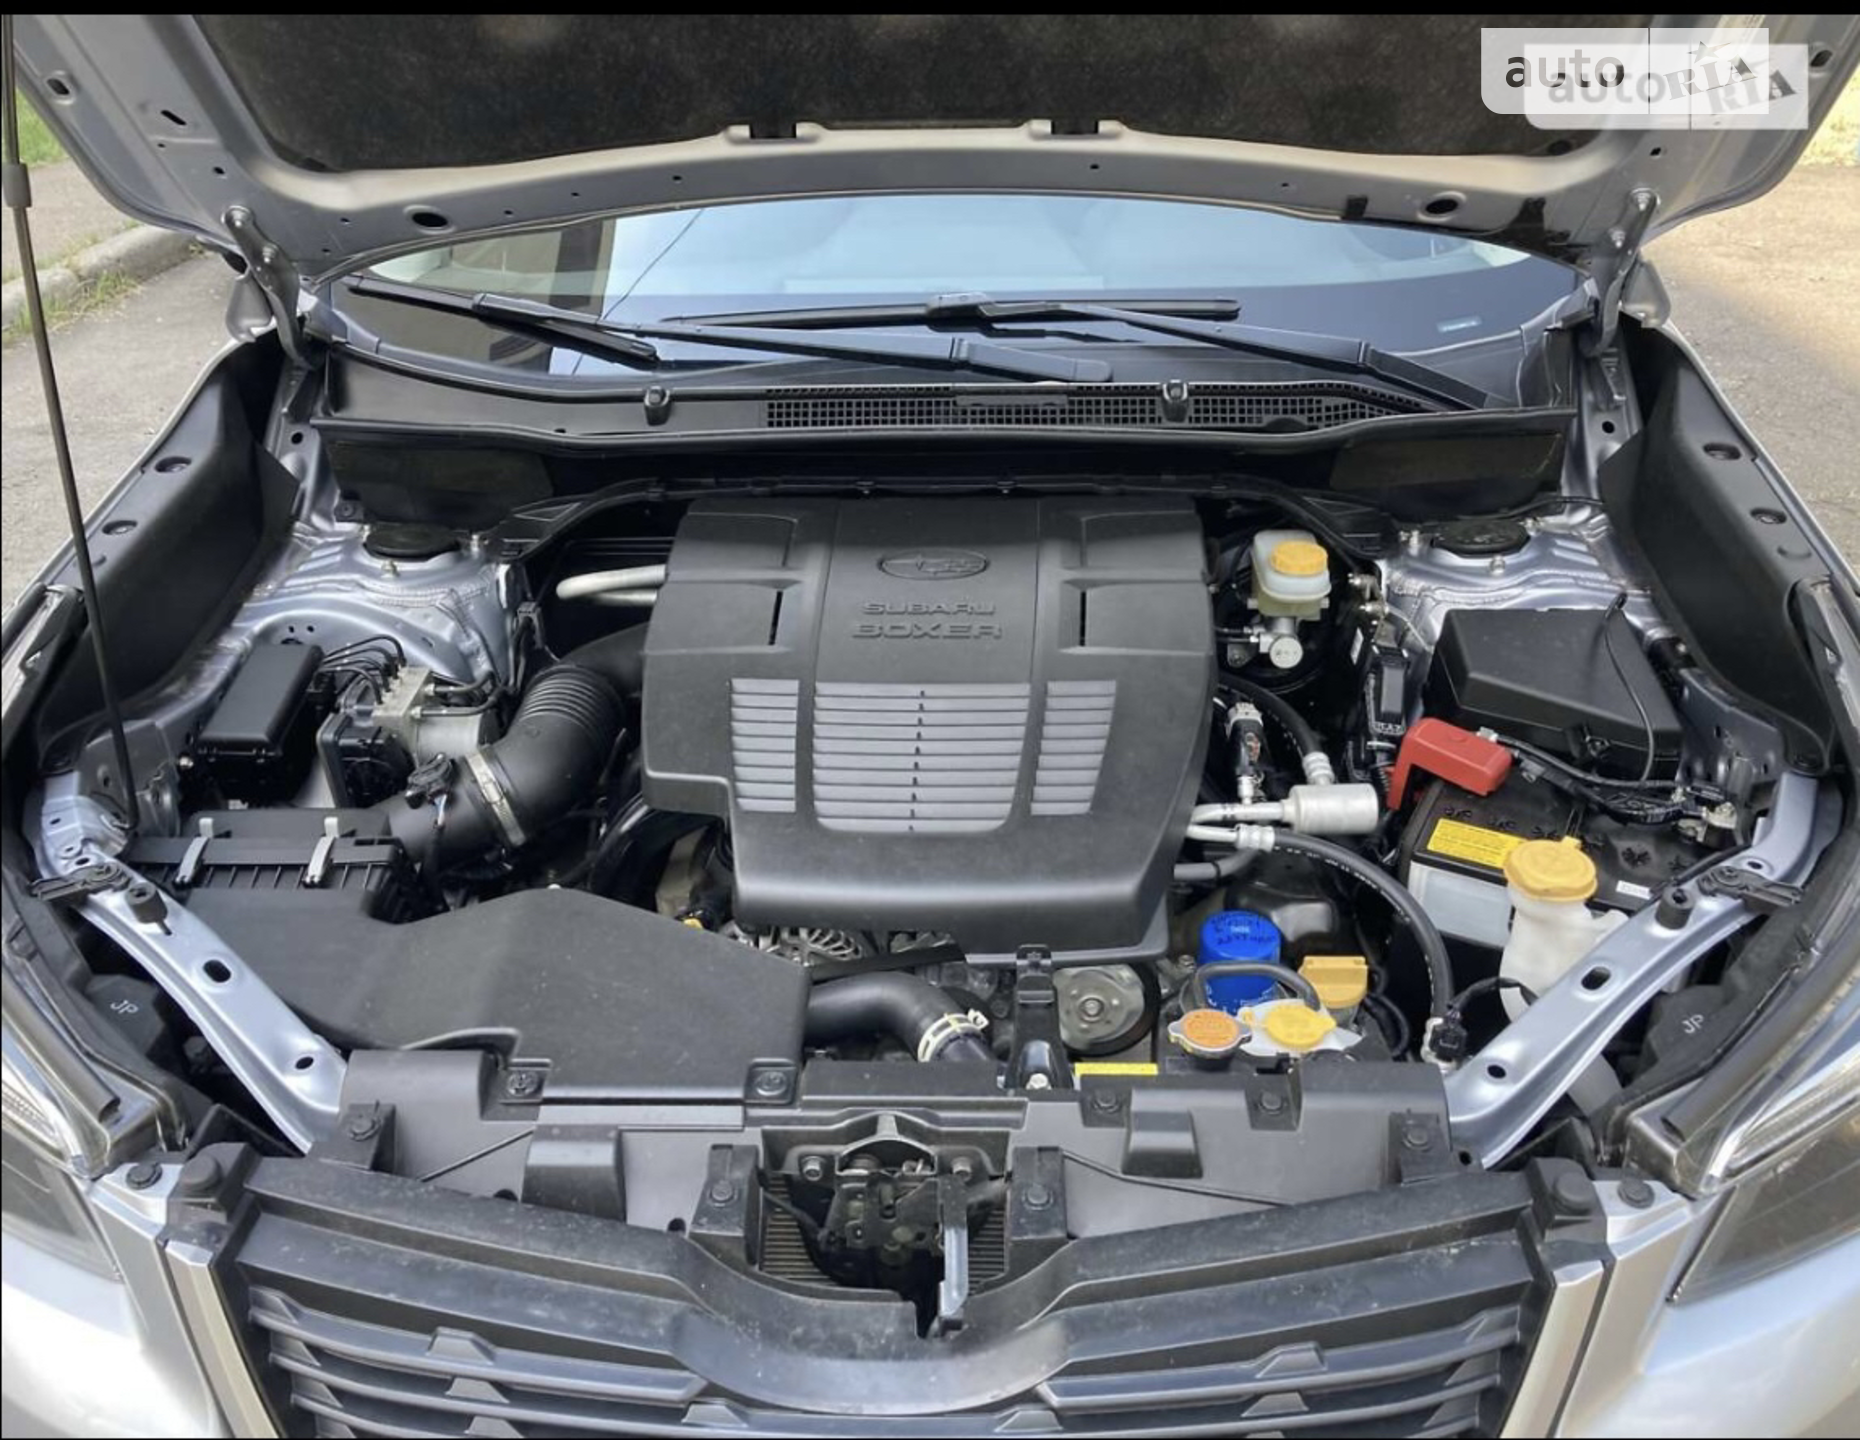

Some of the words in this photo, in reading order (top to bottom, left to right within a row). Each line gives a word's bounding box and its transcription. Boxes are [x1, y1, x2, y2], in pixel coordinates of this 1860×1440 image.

[862, 601, 996, 616] SUBARU
[852, 623, 1003, 640] BOXER
[110, 999, 139, 1014] JP
[1681, 1013, 1705, 1034] JP
